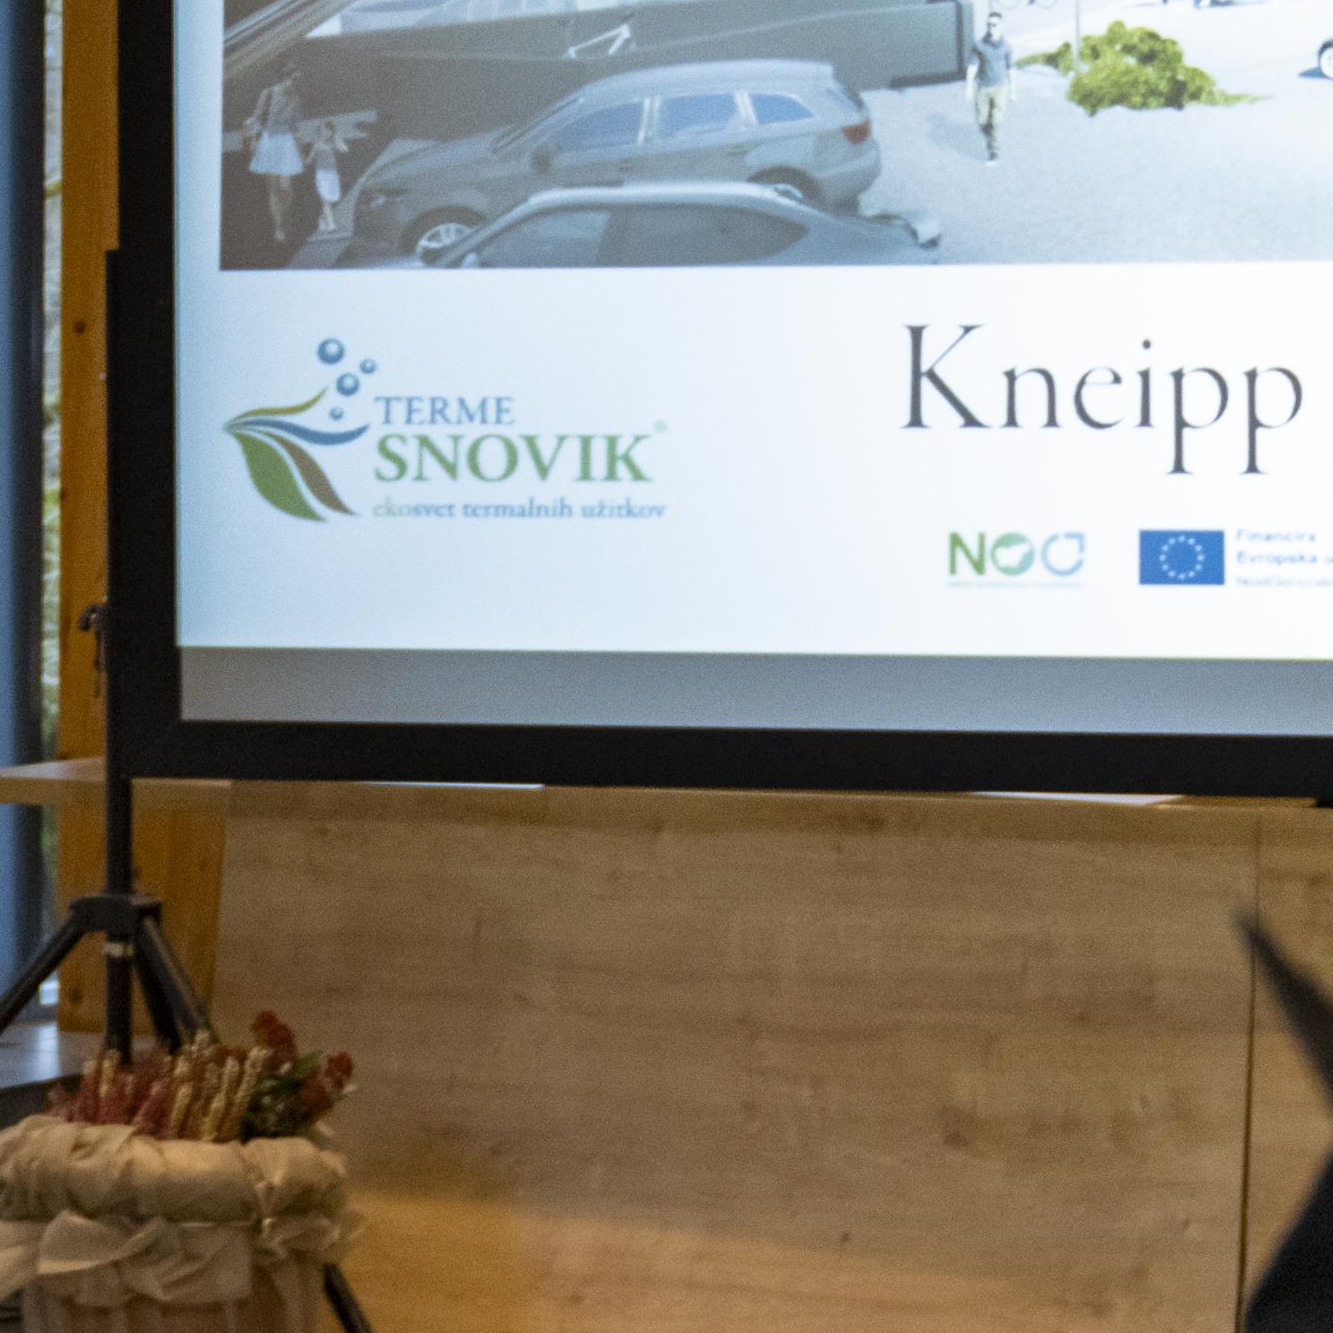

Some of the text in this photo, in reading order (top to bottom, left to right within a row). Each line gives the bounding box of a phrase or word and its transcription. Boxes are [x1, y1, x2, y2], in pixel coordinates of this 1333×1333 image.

[374, 397, 515, 425] TERME
[900, 323, 1304, 475] Kneipp
[374, 434, 652, 482] SNOVIK
[372, 497, 667, 518] ekosvet termalnih užitkov
